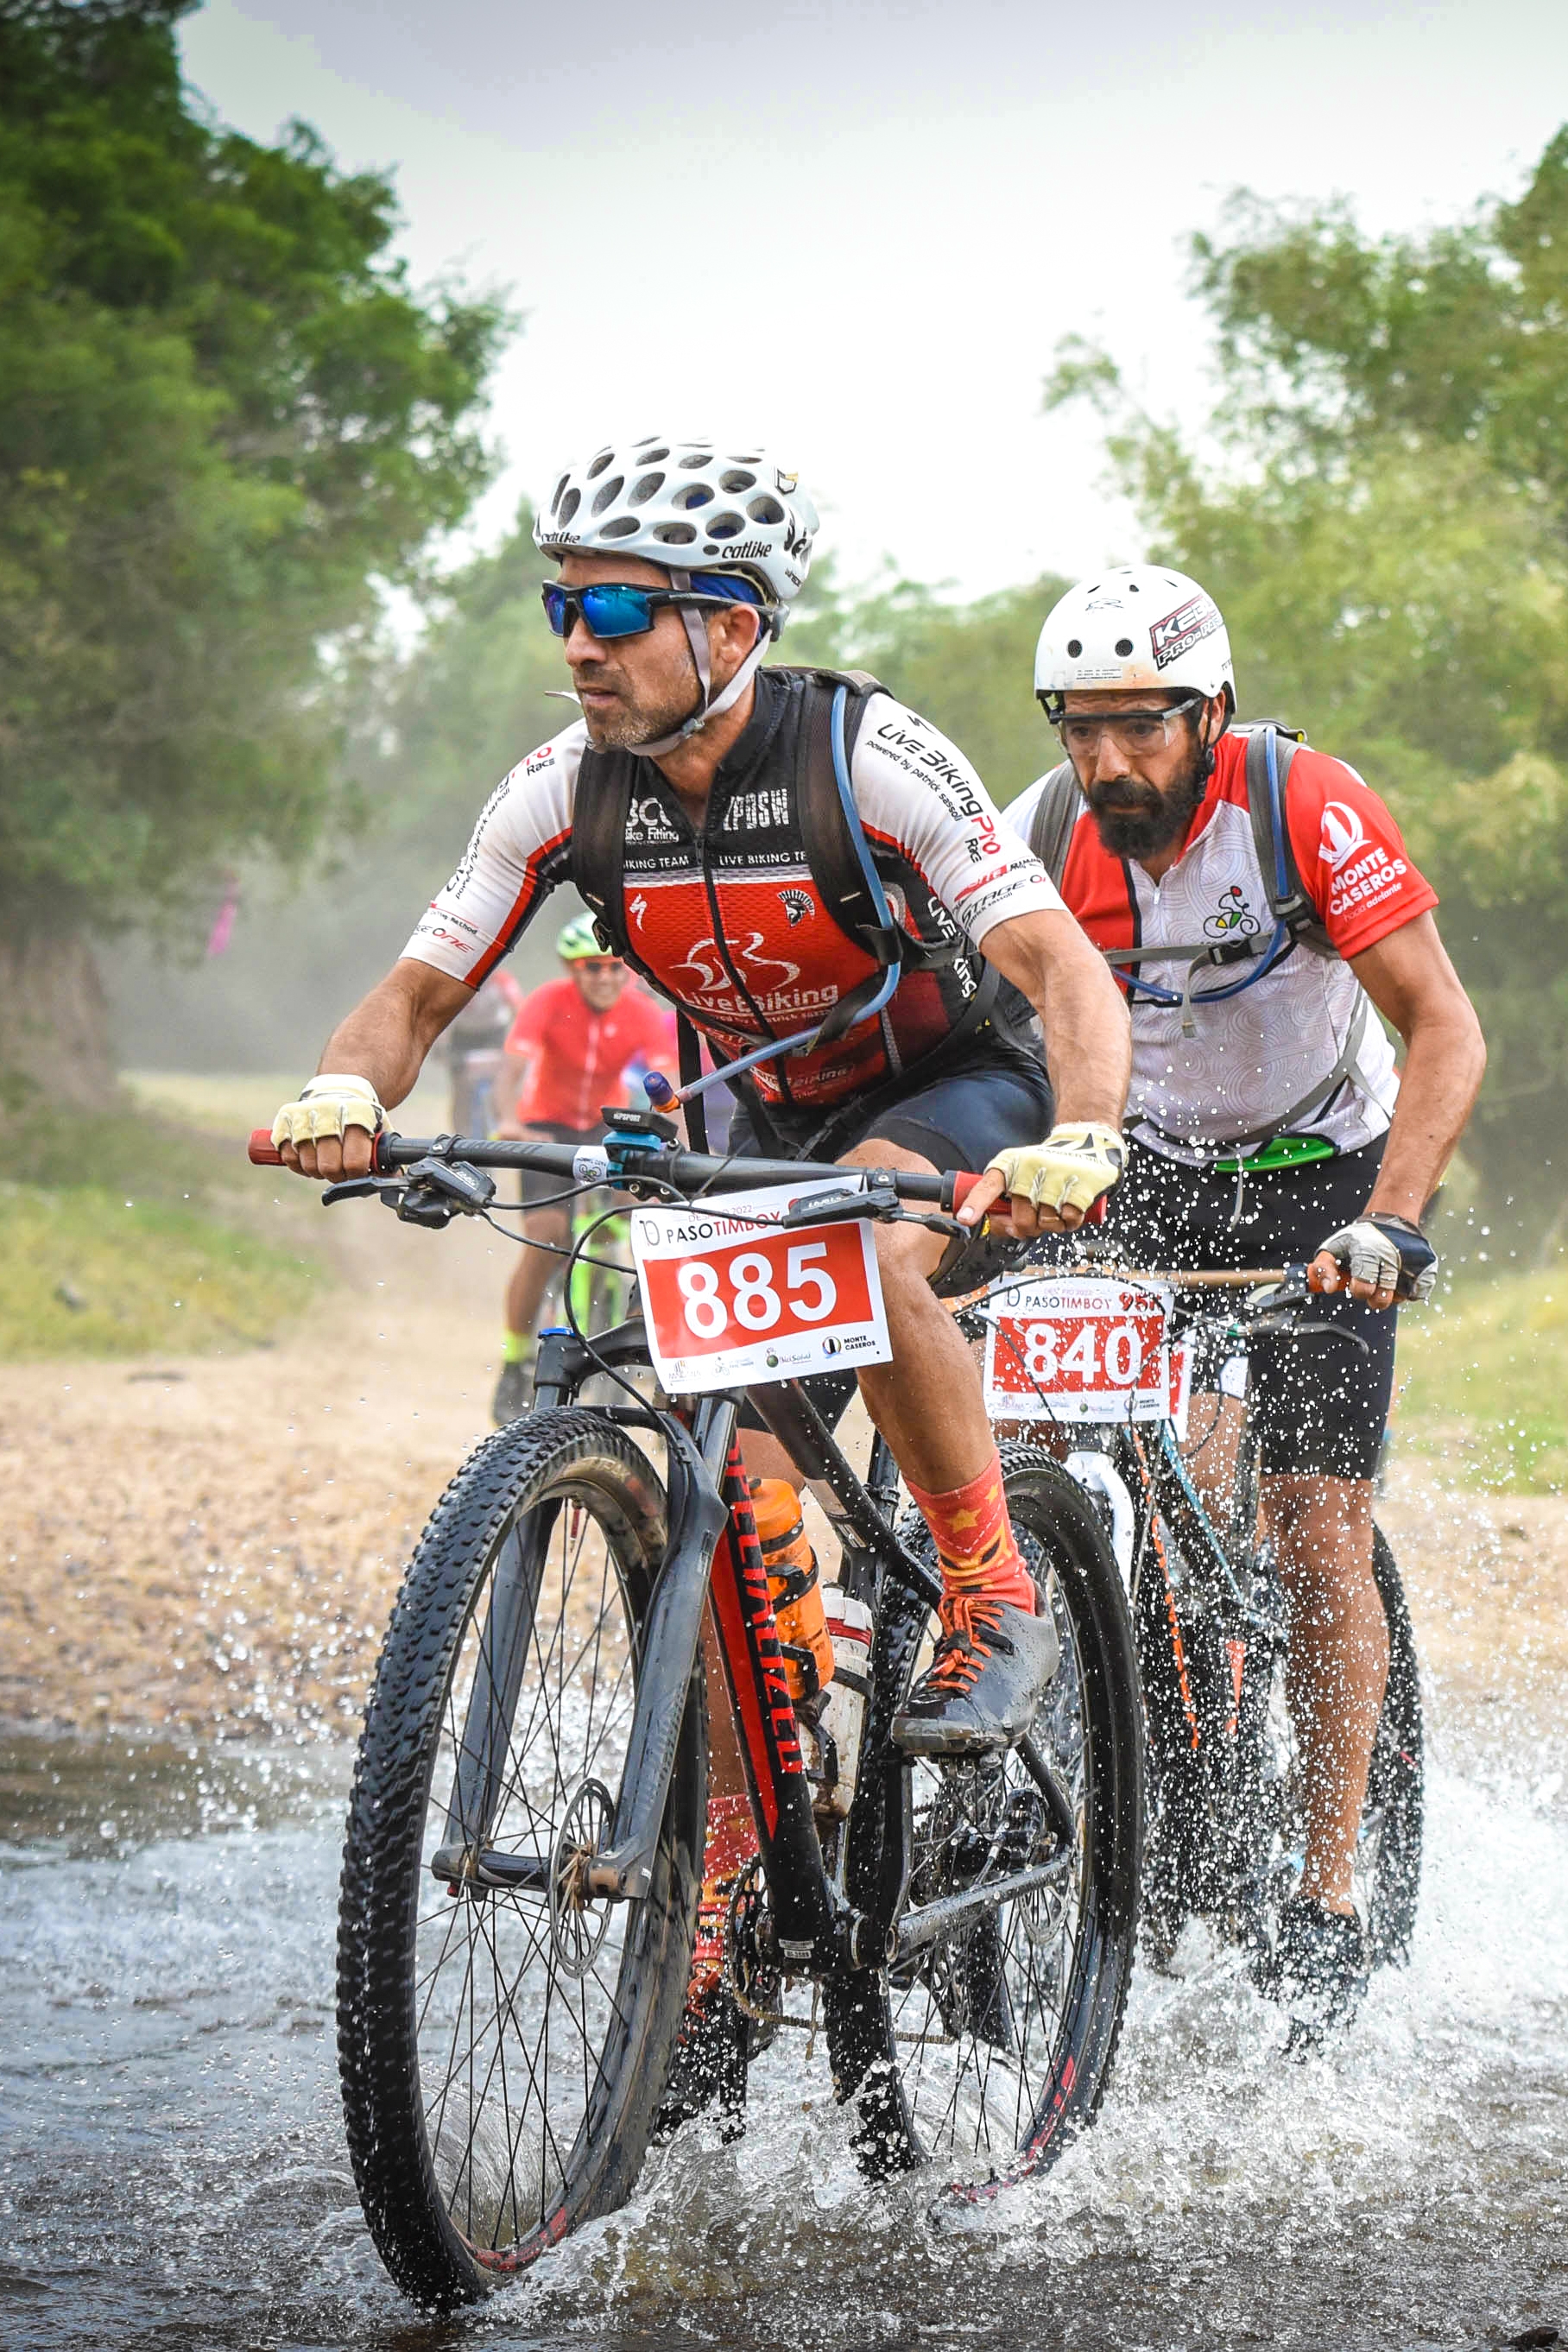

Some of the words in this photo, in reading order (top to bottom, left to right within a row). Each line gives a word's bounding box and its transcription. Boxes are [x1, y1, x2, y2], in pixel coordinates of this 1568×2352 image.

[721, 541, 773, 560] catlike
[865, 740, 902, 762] powered
[900, 758, 914, 771] by
[911, 768, 942, 793] patrick
[938, 793, 964, 822] sassoli
[623, 858, 656, 869] IKING
[658, 855, 689, 869] TEAM
[718, 855, 743, 866] LIVE
[748, 852, 791, 864] BIKING
[1331, 847, 1389, 895] MONTE
[1330, 858, 1407, 916] CASEROS
[1366, 882, 1403, 909] adelante
[678, 1242, 838, 1339] 885
[1025, 1296, 1113, 1311] PASOTIMBOY
[844, 1335, 867, 1344] MONTE
[844, 1340, 876, 1350] CASEROS
[1023, 1323, 1142, 1386] 840
